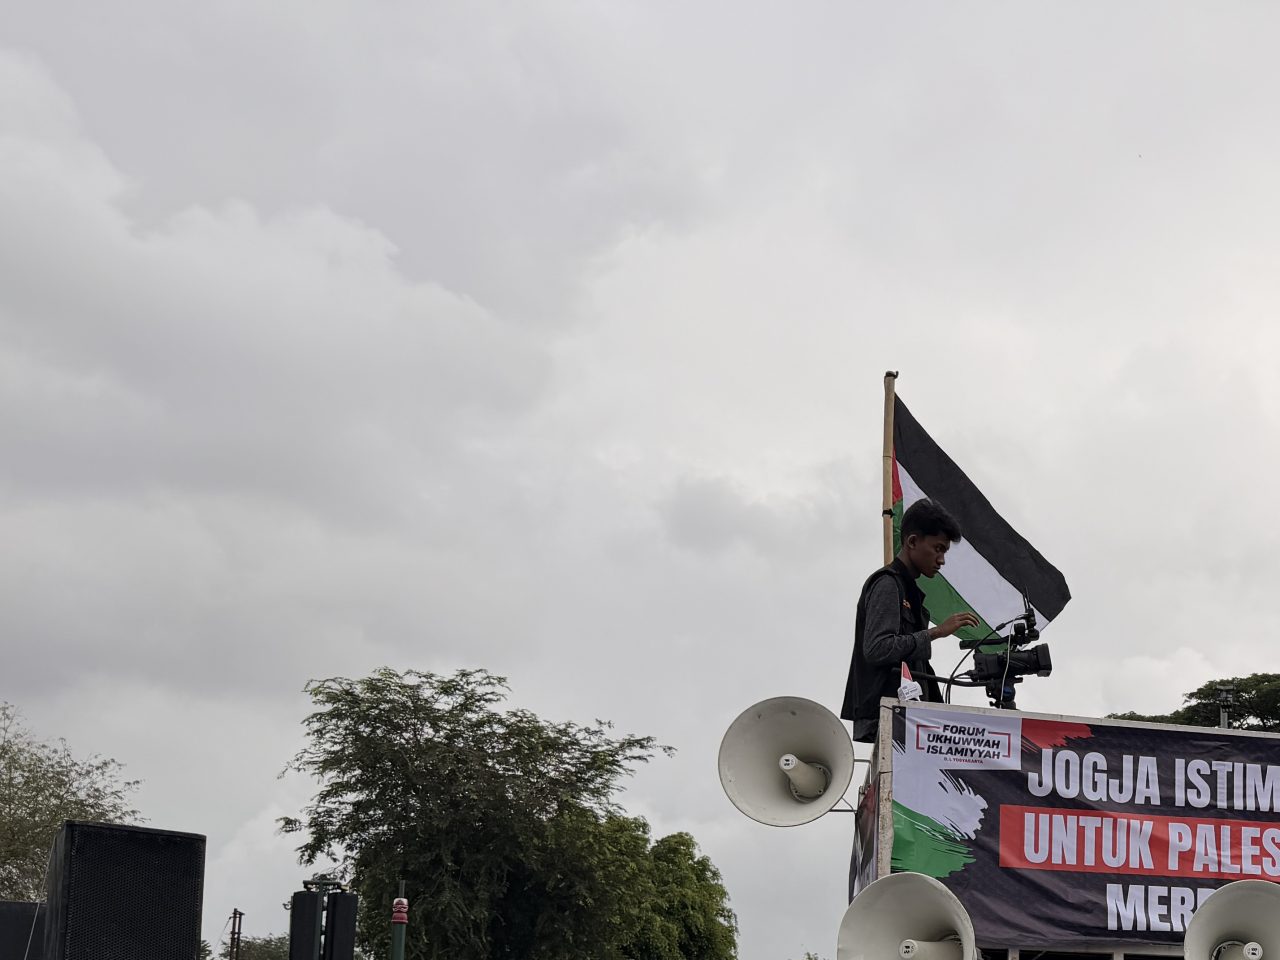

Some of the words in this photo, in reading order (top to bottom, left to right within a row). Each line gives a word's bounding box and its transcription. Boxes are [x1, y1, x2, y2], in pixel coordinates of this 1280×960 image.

[943, 725, 985, 736] FORUM
[927, 734, 1000, 749] UKHUWWAH
[927, 745, 1000, 759] ISLAMIYYAH
[1027, 748, 1160, 805] JOGJA
[1024, 812, 1154, 869] UNTUK
